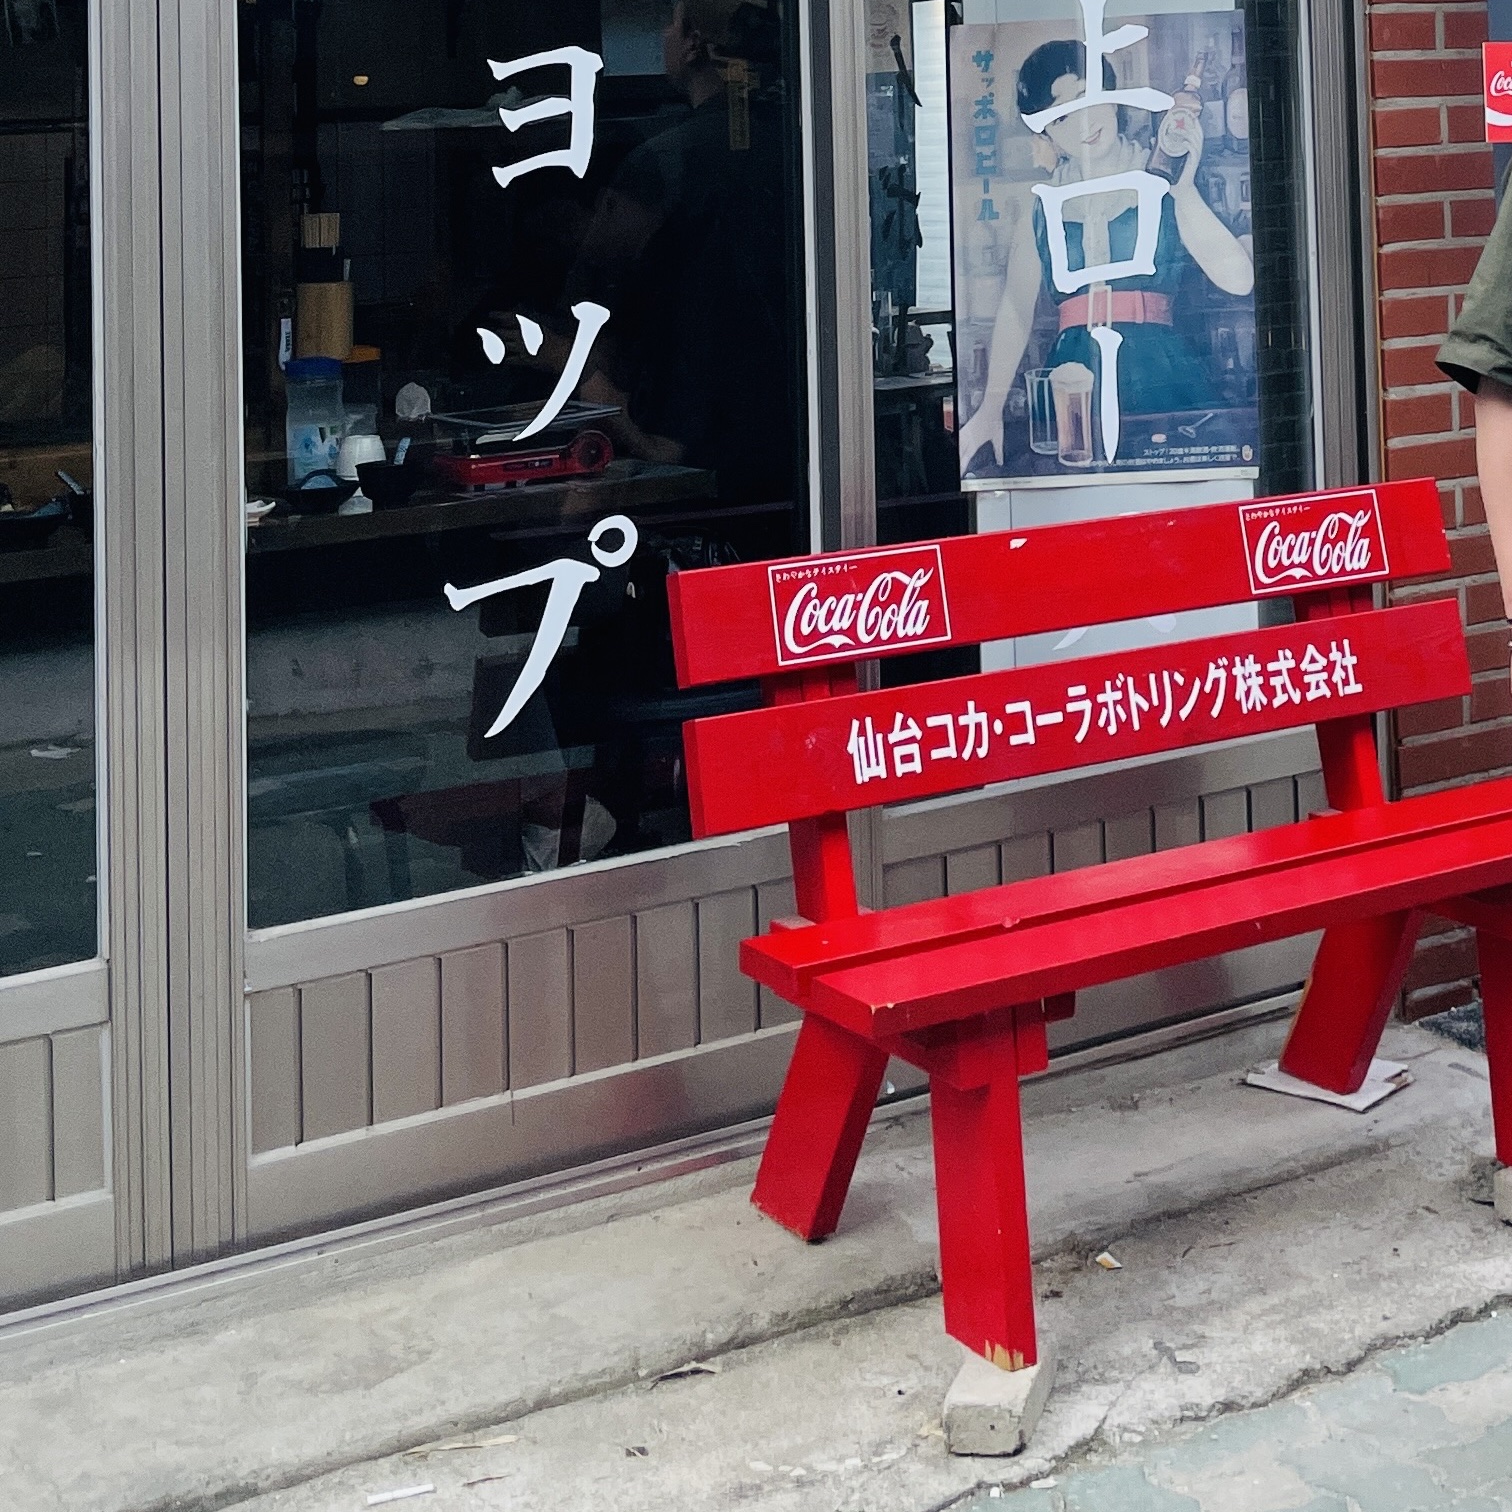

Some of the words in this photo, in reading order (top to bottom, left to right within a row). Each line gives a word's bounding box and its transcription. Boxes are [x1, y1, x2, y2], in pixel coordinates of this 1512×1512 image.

[972, 49, 999, 222] サッポロビール
[1254, 508, 1372, 584] Coca-Cola
[784, 566, 934, 655] Coca-Cola
[846, 637, 1363, 785] 仙台コカ・コーラボトリング株式会社
